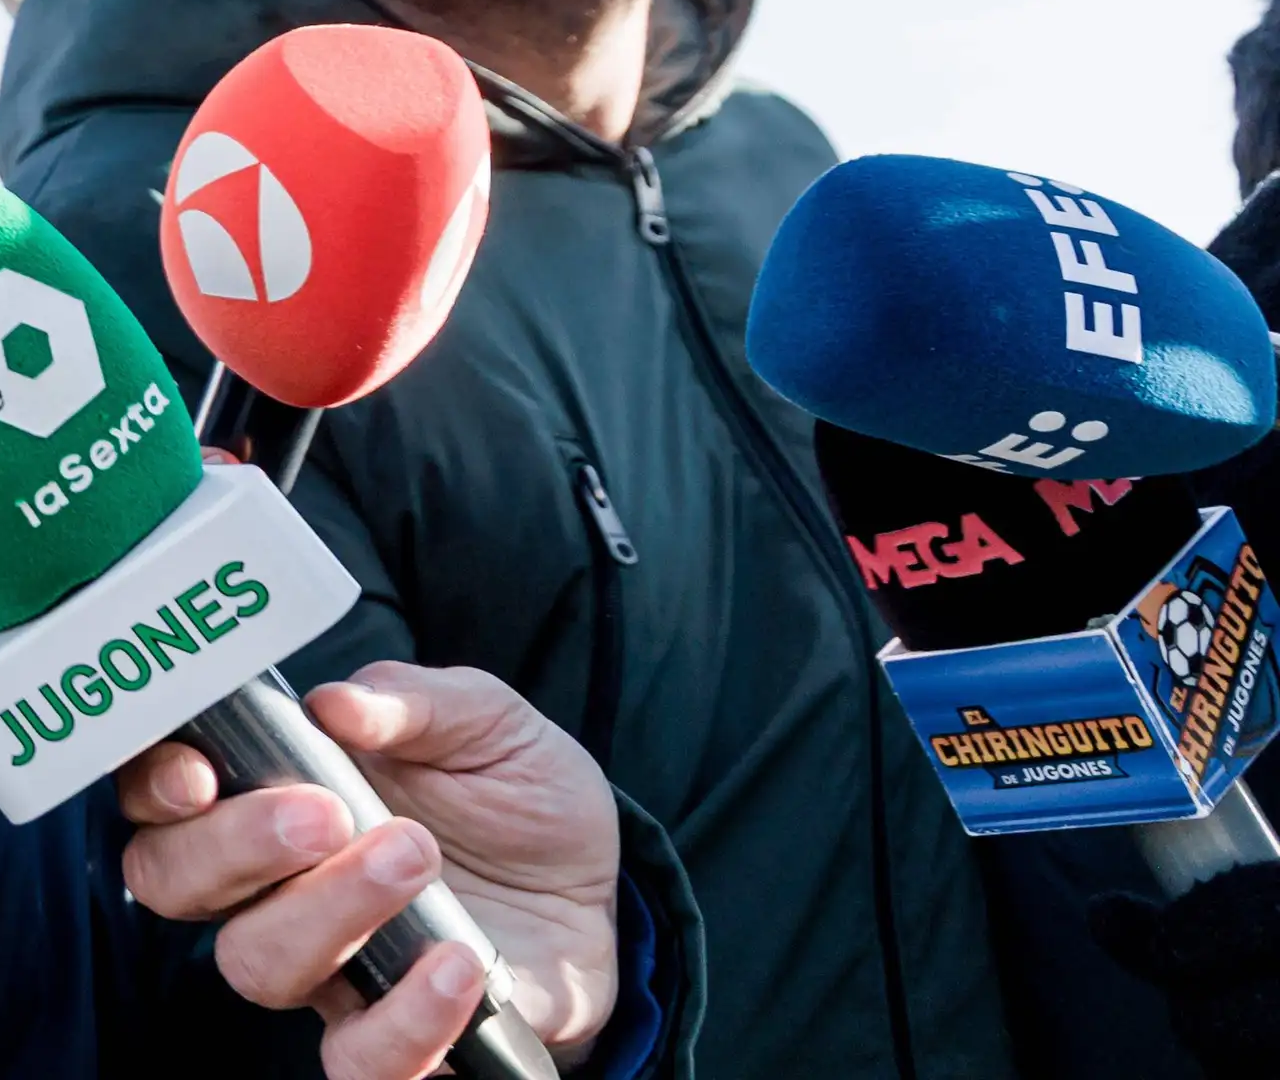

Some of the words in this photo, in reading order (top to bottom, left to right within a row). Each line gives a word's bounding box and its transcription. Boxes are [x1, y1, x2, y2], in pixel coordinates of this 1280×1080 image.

[15, 382, 171, 528] laSexta
[845, 512, 1026, 590] MEGA
[0, 560, 270, 767] JUGONES
[1222, 734, 1238, 757] DE
[1230, 629, 1268, 732] JUGONES
[931, 715, 1154, 767] CHIRINGUITO
[962, 709, 990, 726] EL
[1001, 773, 1019, 785] DE
[1023, 759, 1113, 784] JUGONES
